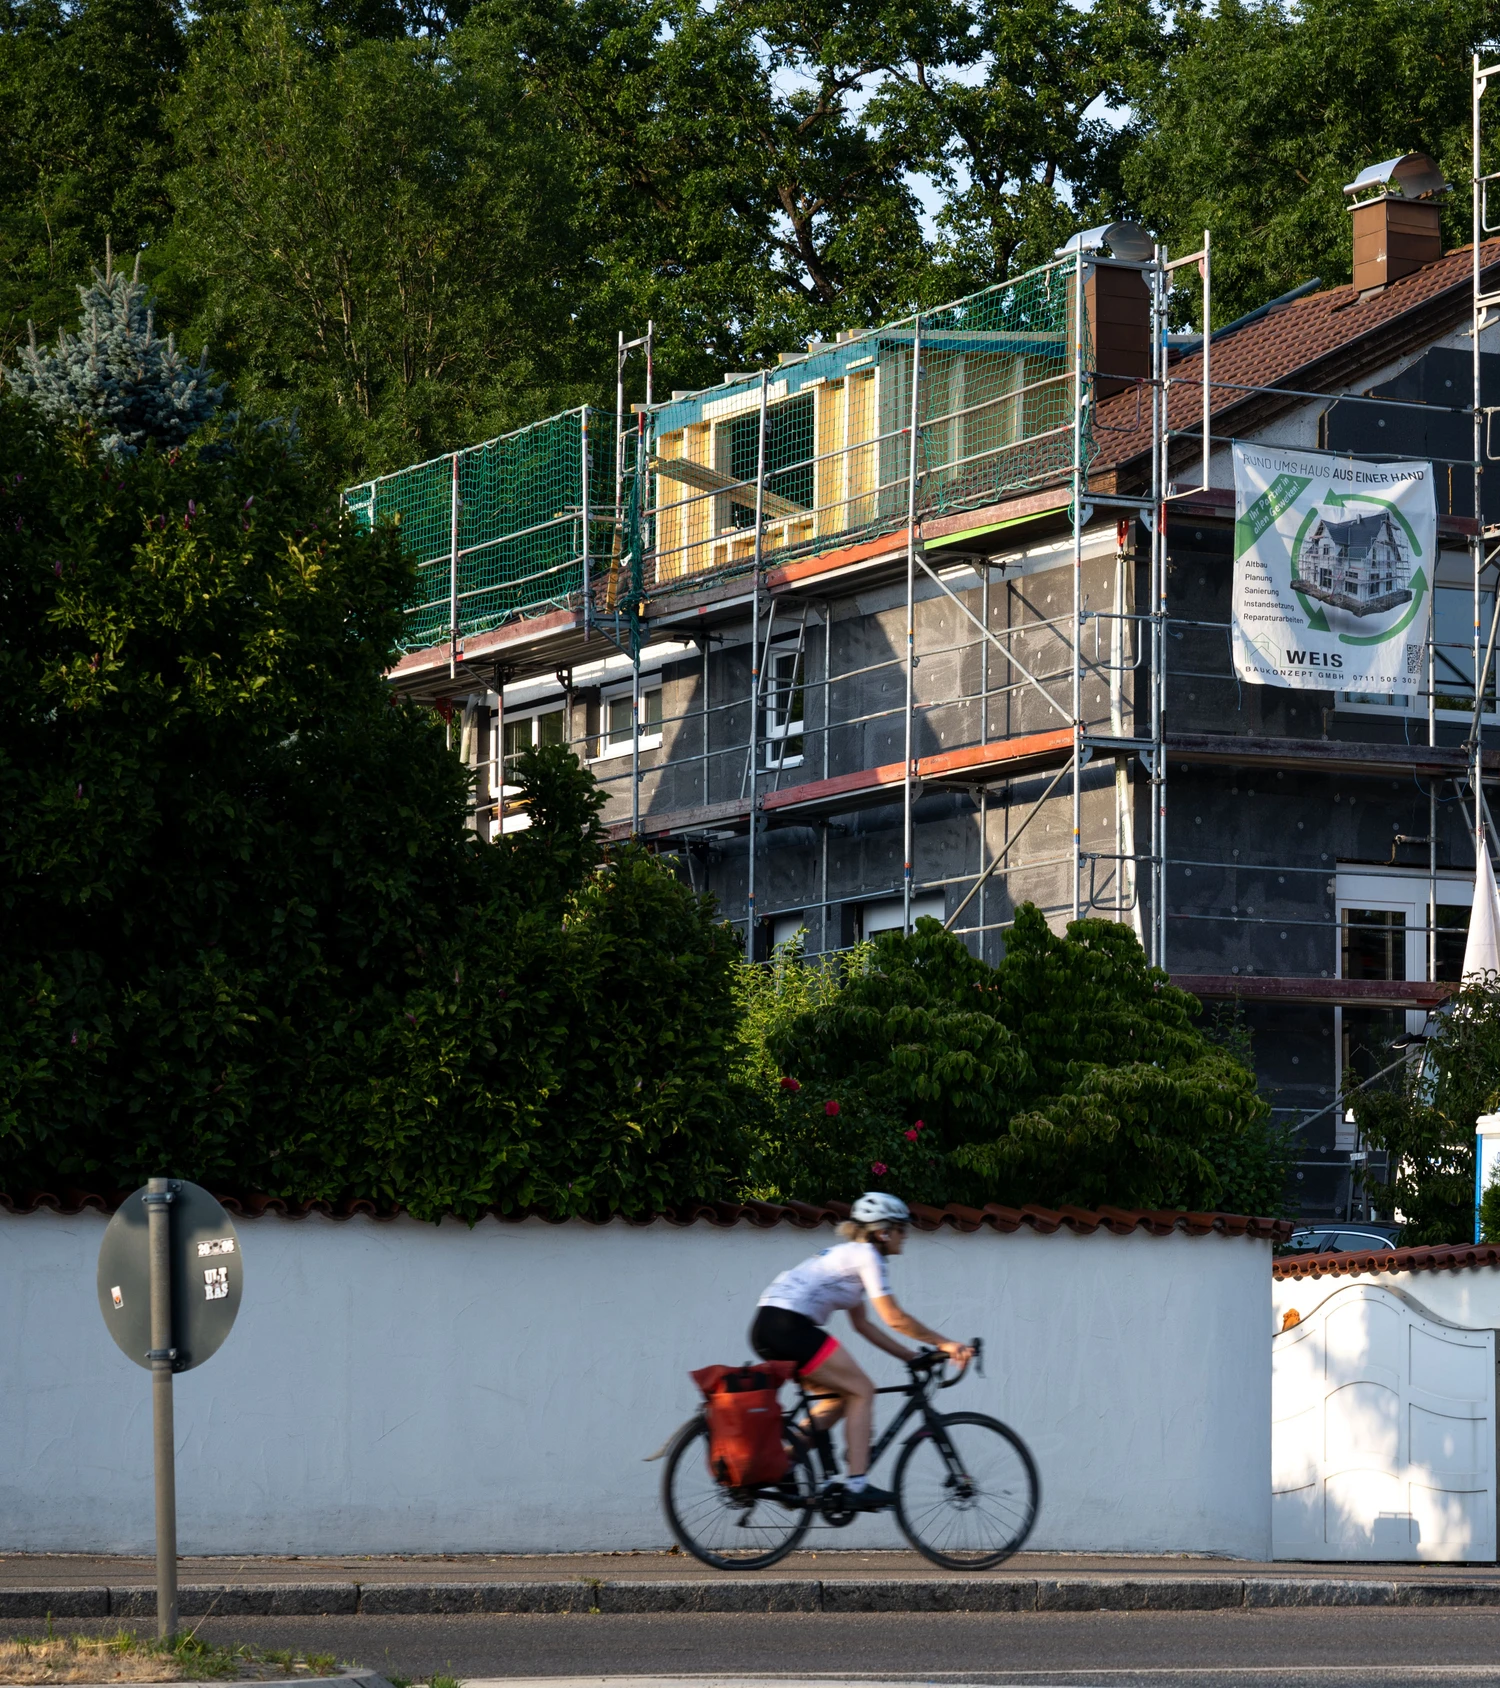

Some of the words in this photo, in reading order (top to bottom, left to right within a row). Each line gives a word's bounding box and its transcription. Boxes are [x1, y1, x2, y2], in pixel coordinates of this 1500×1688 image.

[1243, 453, 1271, 469] RUND
[1274, 461, 1297, 474] UMS
[1300, 464, 1330, 478] HAUS
[1333, 467, 1353, 482] AUS
[1355, 470, 1388, 483] EINER
[1391, 470, 1424, 482] HAND
[1248, 507, 1260, 522] Ihr
[1258, 482, 1284, 510] Partner
[1281, 476, 1290, 488] in
[1253, 515, 1270, 536] allen
[1268, 480, 1302, 517] Gewerken!
[1245, 560, 1268, 569] Altbau
[1245, 573, 1273, 583] Planung
[1244, 586, 1280, 597] Sanierung
[1243, 600, 1295, 611] Instandsetzung
[1243, 612, 1304, 624] Reparaturarbeiten
[1286, 649, 1343, 668] WEIS
[1245, 665, 1313, 678] BAUKONZEPT
[1318, 671, 1344, 680] GMBH
[1353, 674, 1375, 682] 0711
[1380, 675, 1398, 683] 505
[205, 1283, 228, 1300] RAS
